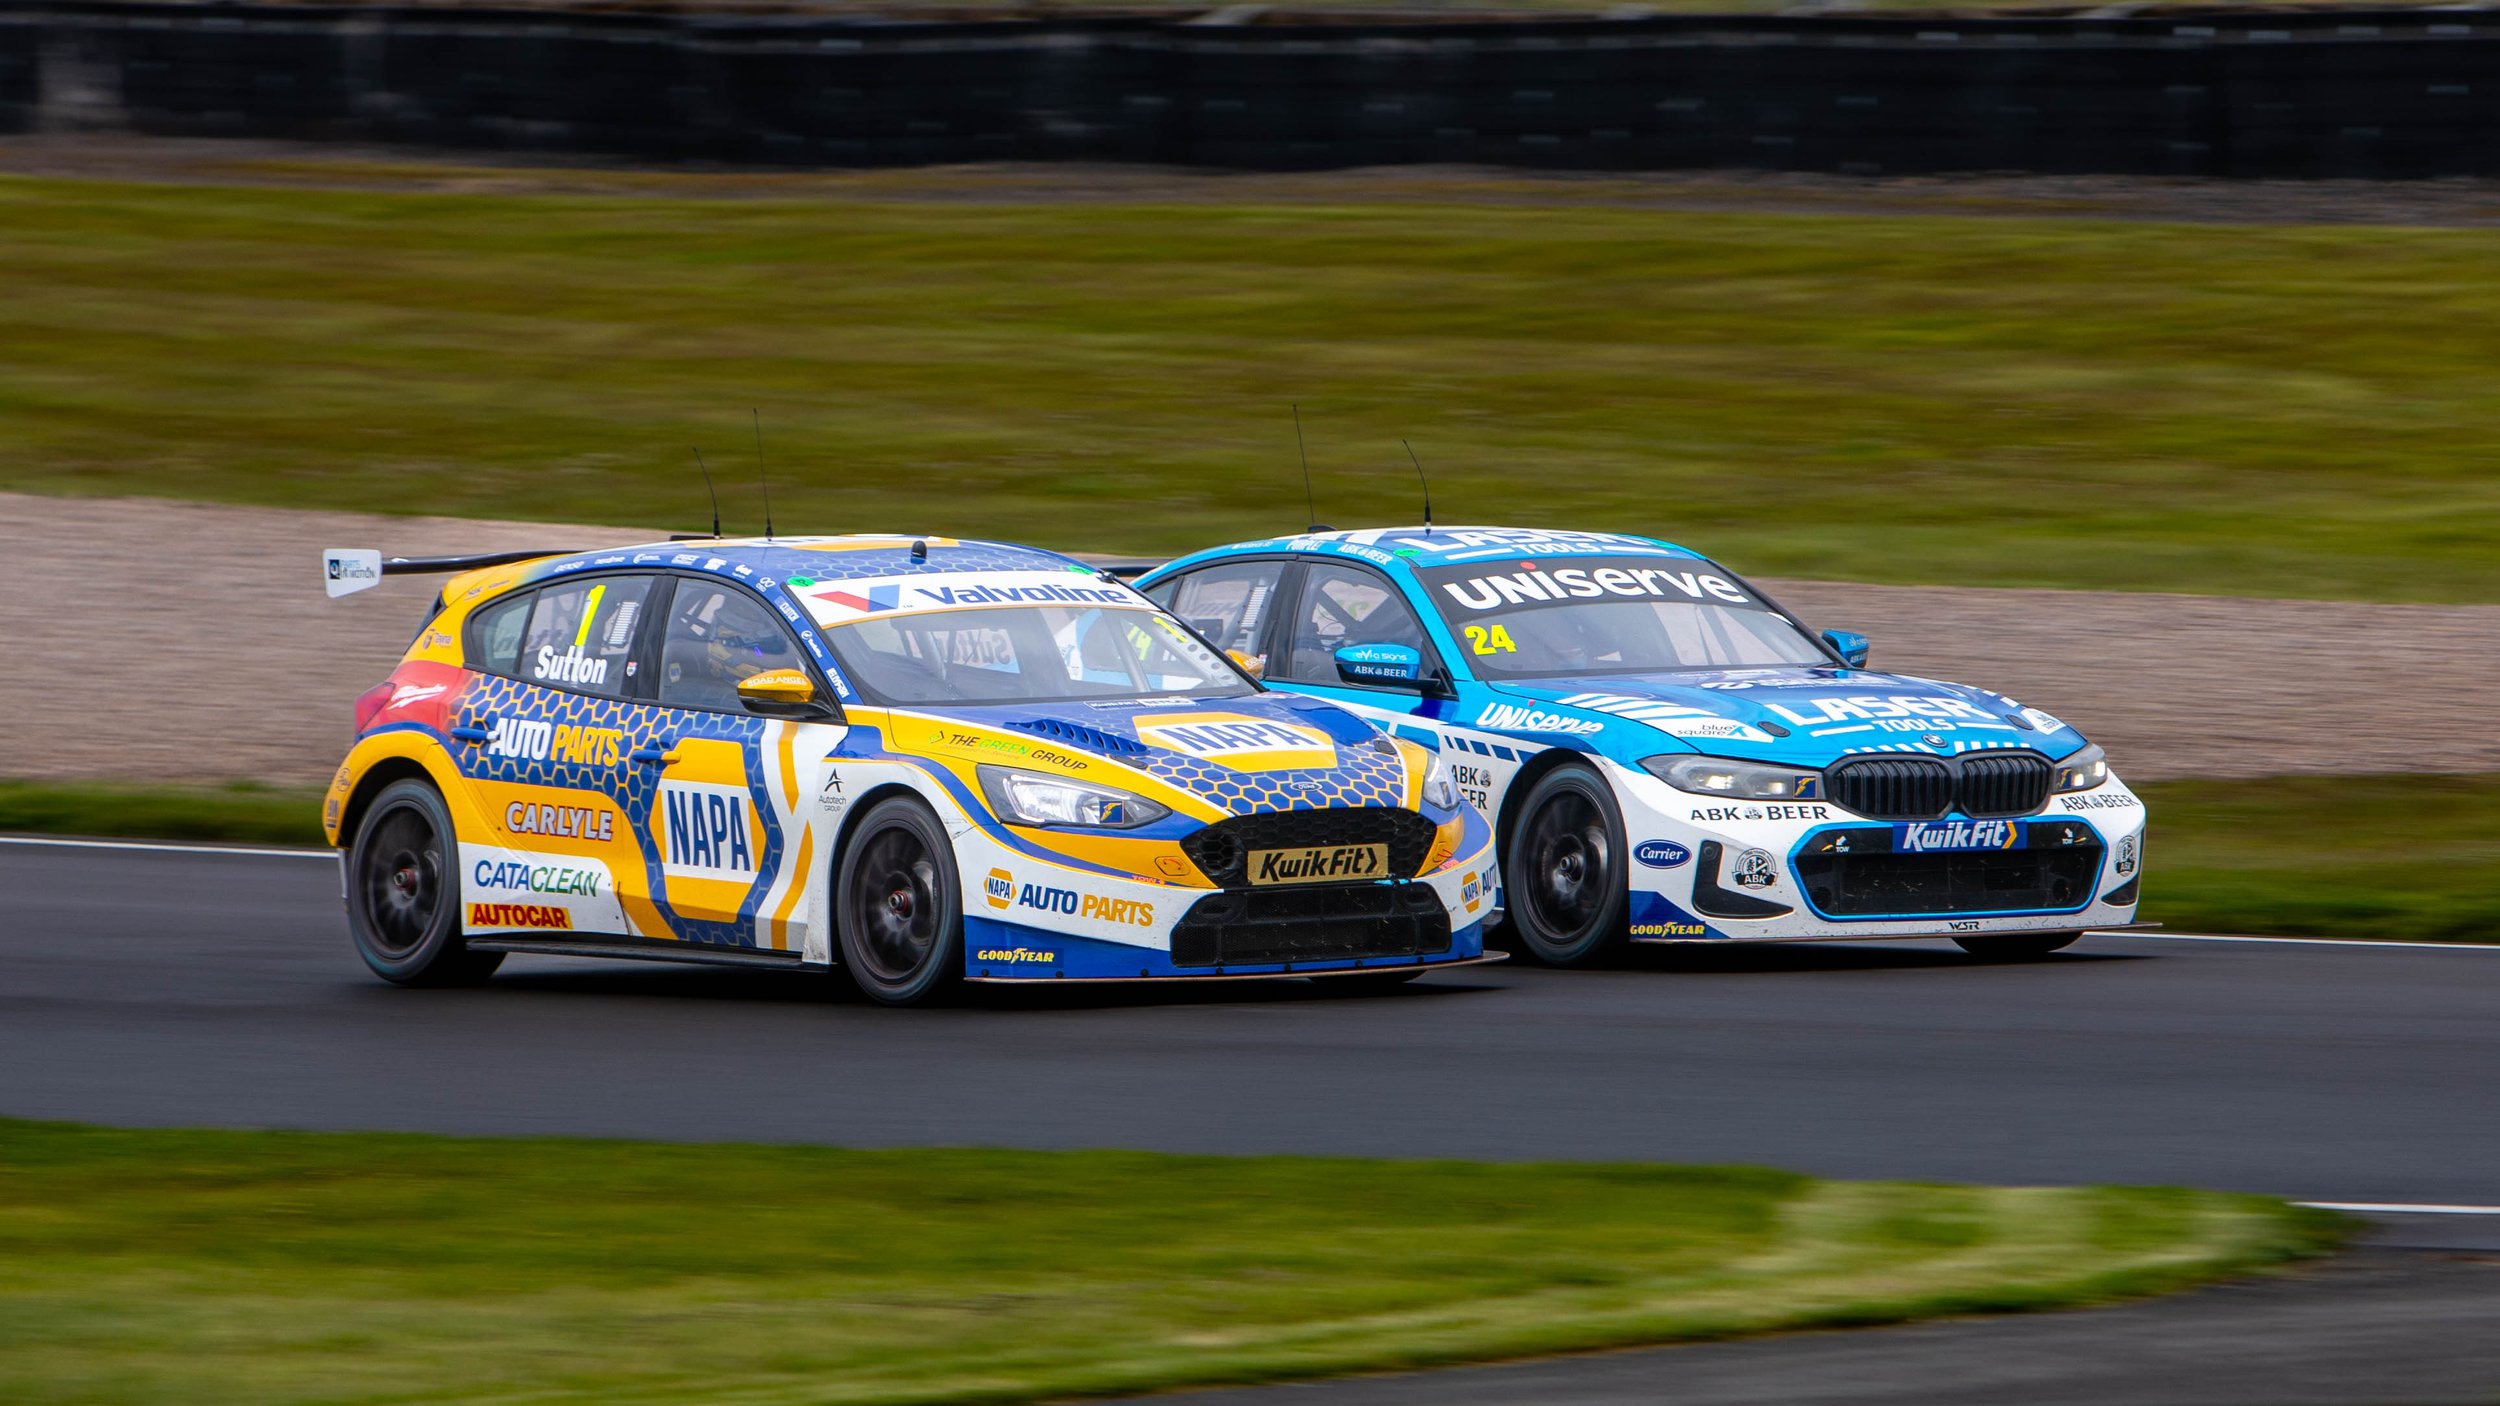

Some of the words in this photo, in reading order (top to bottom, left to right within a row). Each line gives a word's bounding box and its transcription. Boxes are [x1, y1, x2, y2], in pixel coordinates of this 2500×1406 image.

[1392, 528, 1654, 552] LASER
[1511, 543, 1602, 555] TOOLS
[914, 584, 1134, 605] Valvoline
[573, 584, 607, 647] 1
[1464, 625, 1517, 656] 24
[534, 645, 608, 684] Sutton
[1354, 666, 1374, 675] ABK
[1383, 668, 1407, 678] BEER
[776, 675, 807, 686] ANGEL
[1764, 696, 2000, 726] LASER
[1156, 723, 1310, 752] NAPA
[1872, 718, 1957, 733] TOOLS
[487, 718, 551, 761] AUTO
[551, 724, 623, 767] PARTS
[949, 734, 981, 747] THE
[979, 738, 1031, 756] GREEN
[1031, 749, 1088, 770] GROUP
[818, 795, 847, 805] Autotech
[2060, 795, 2094, 812] ABK
[2098, 794, 2140, 808] BEER
[506, 801, 612, 841] CARLYLE
[1691, 807, 1741, 821] ABK
[1767, 806, 1830, 820] BEER
[667, 790, 751, 871] NAPA
[1640, 847, 1683, 860] Carrier
[475, 860, 601, 897] CATACLEAN
[1744, 875, 1767, 885] ABK
[987, 877, 1011, 900] NAPA
[1018, 883, 1078, 914] AUTO
[1081, 895, 1154, 927] PARTS
[472, 904, 568, 928] AUTOCAR
[1949, 921, 1979, 930] WSR
